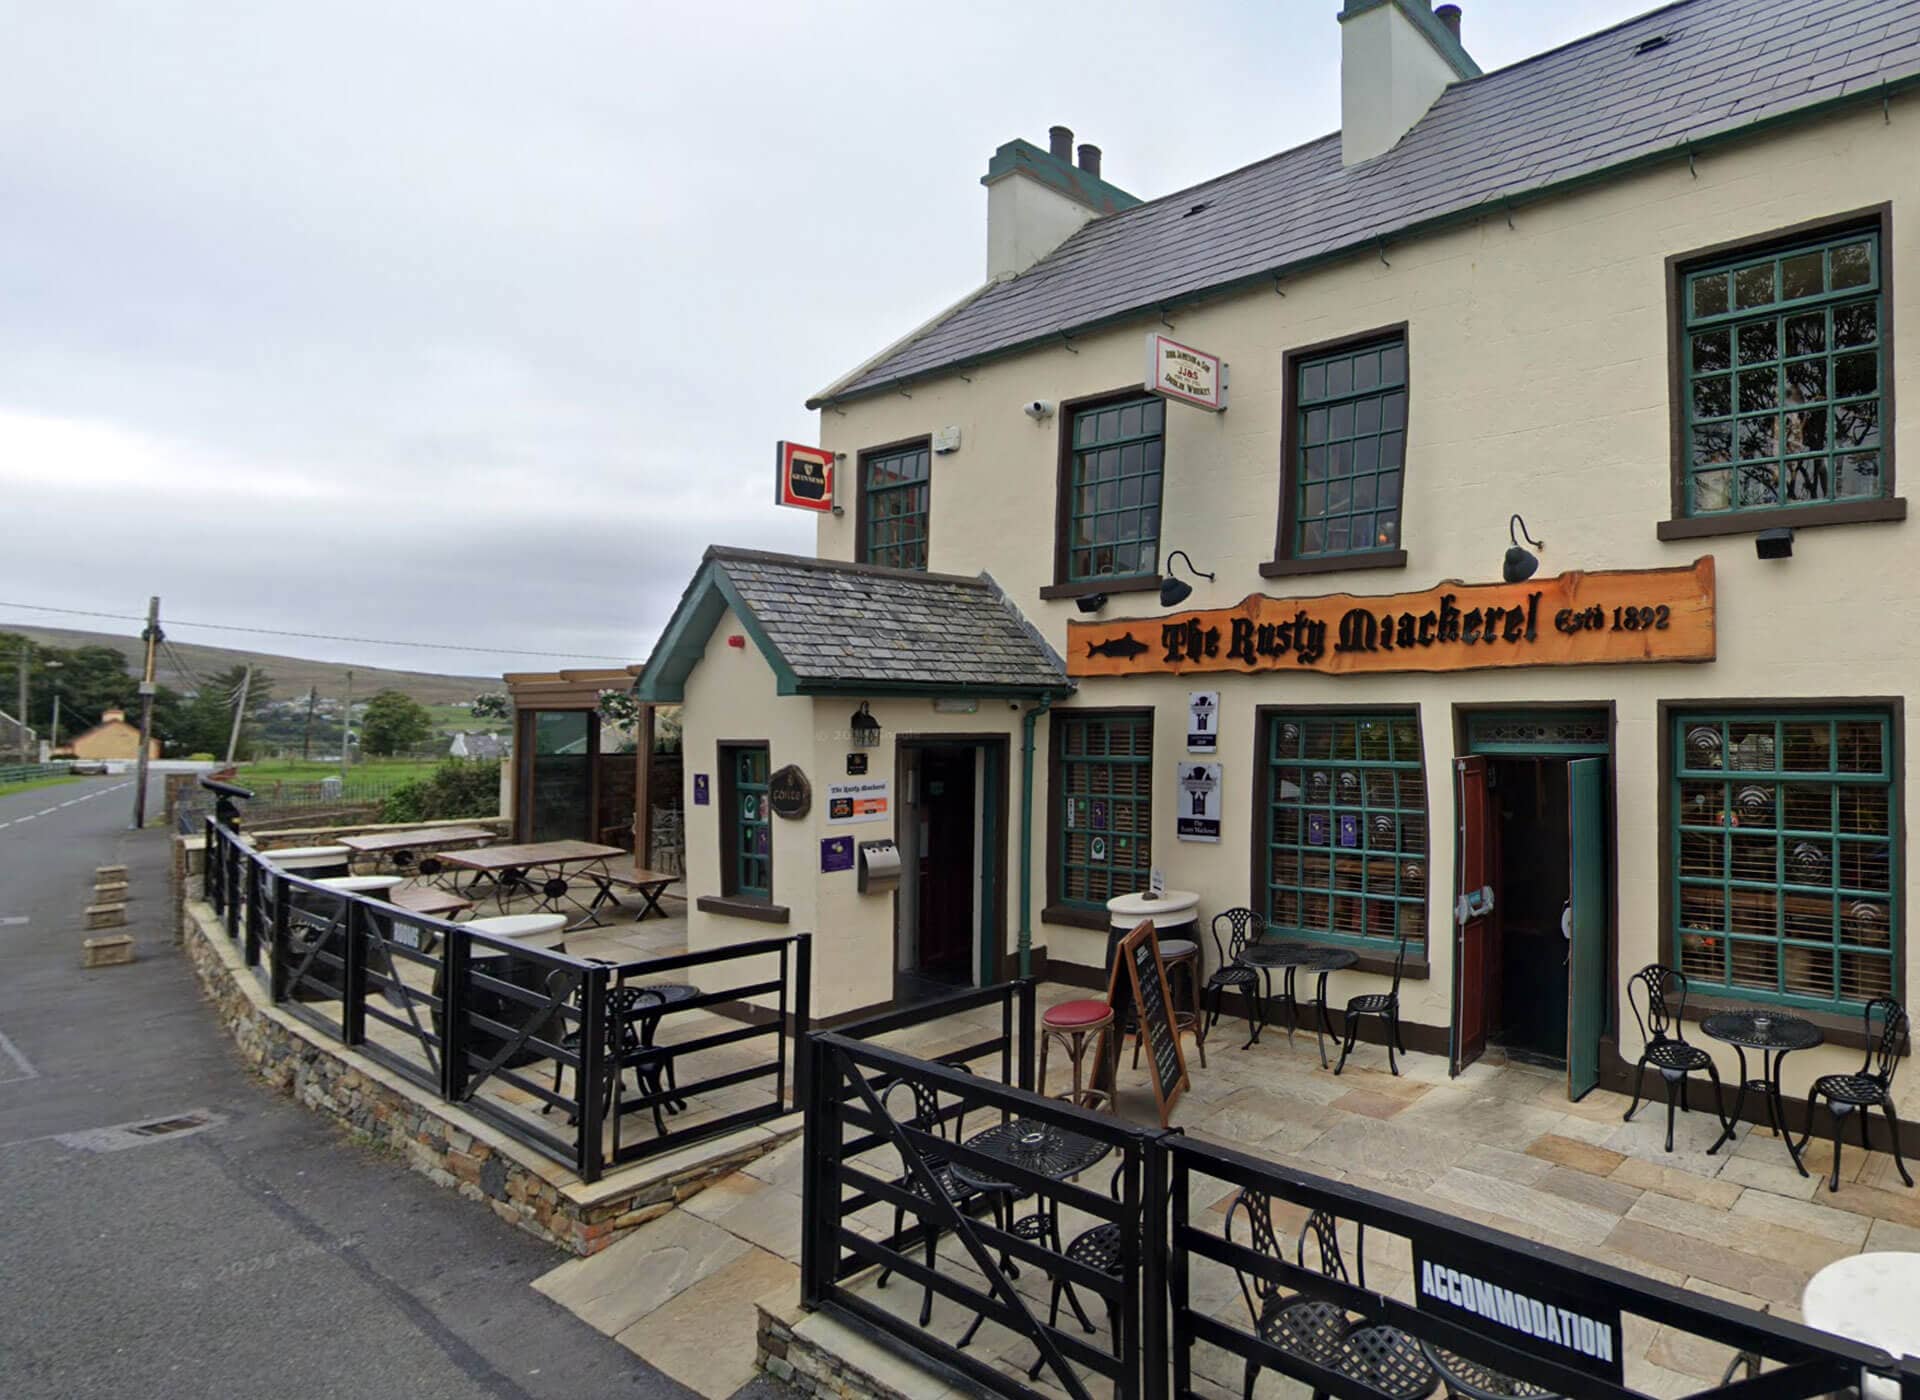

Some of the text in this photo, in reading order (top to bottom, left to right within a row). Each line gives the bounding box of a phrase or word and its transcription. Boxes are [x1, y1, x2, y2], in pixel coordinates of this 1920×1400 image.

[1178, 366, 1199, 380] JJ&S
[792, 474, 824, 484] GUINNESS
[1161, 620, 1221, 664] The
[1226, 610, 1328, 666] Rusty
[1334, 593, 1542, 655] Mackerel
[1611, 605, 1671, 632] 1892
[1421, 1259, 1613, 1363] ACCOMMODATION
